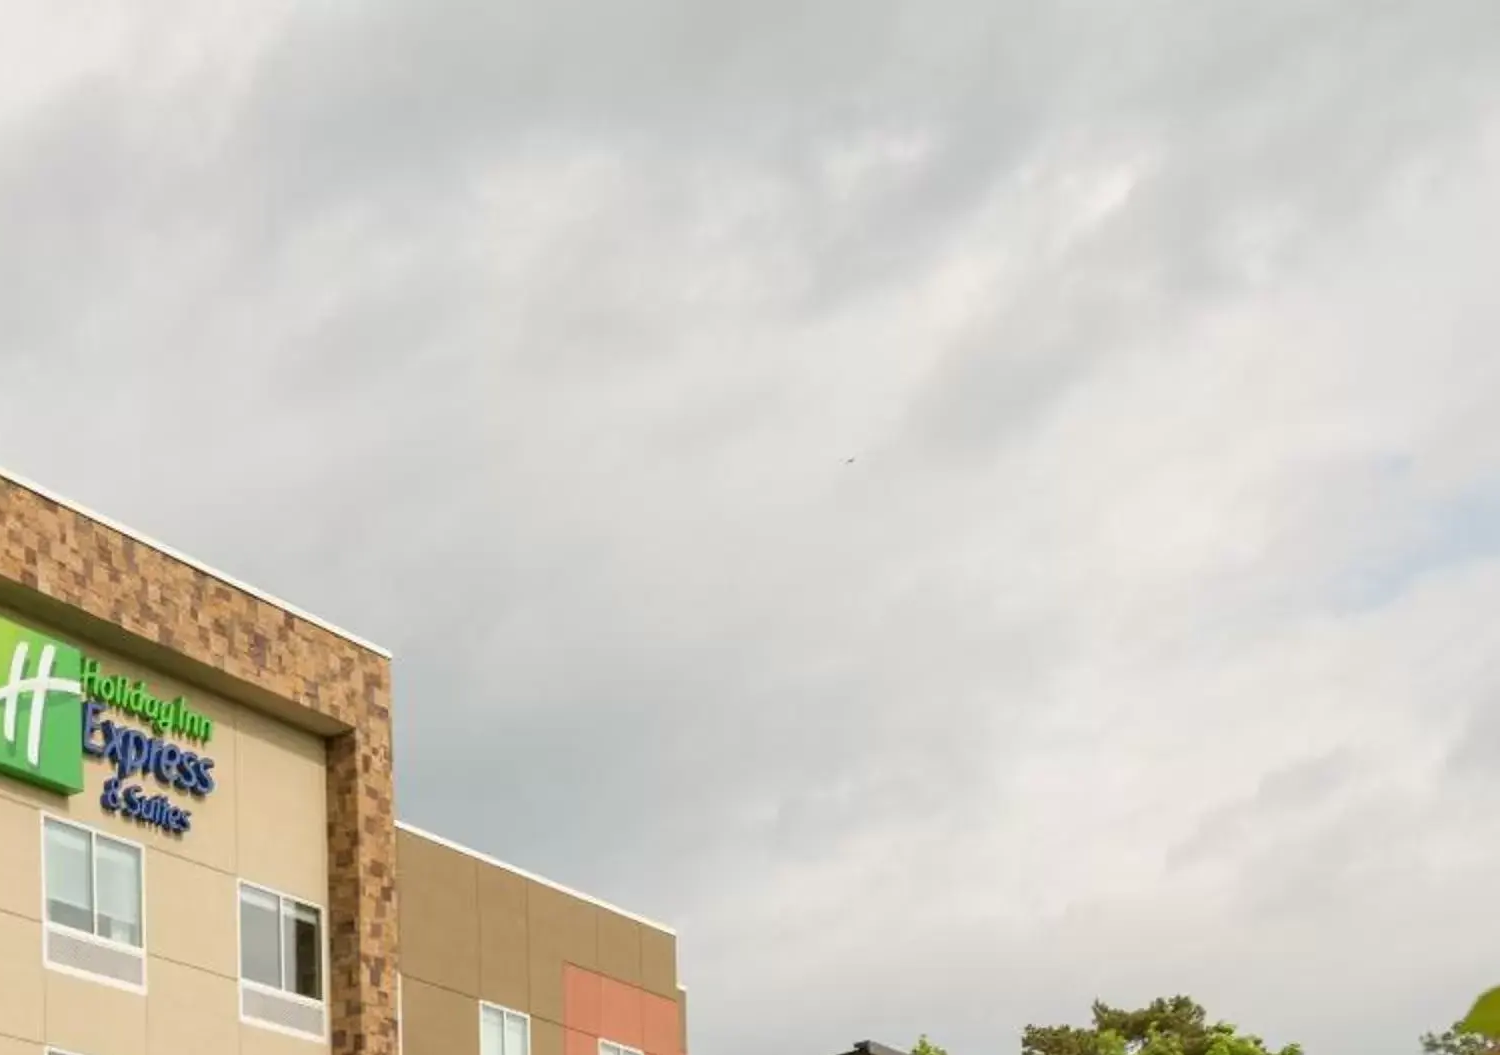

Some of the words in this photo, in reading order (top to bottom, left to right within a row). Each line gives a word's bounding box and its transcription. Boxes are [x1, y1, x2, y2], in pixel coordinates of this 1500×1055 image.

[83, 656, 176, 734] Holiday
[177, 695, 213, 743] Inn
[82, 700, 215, 798] Express
[100, 777, 122, 811] &
[122, 785, 192, 834] Suites
